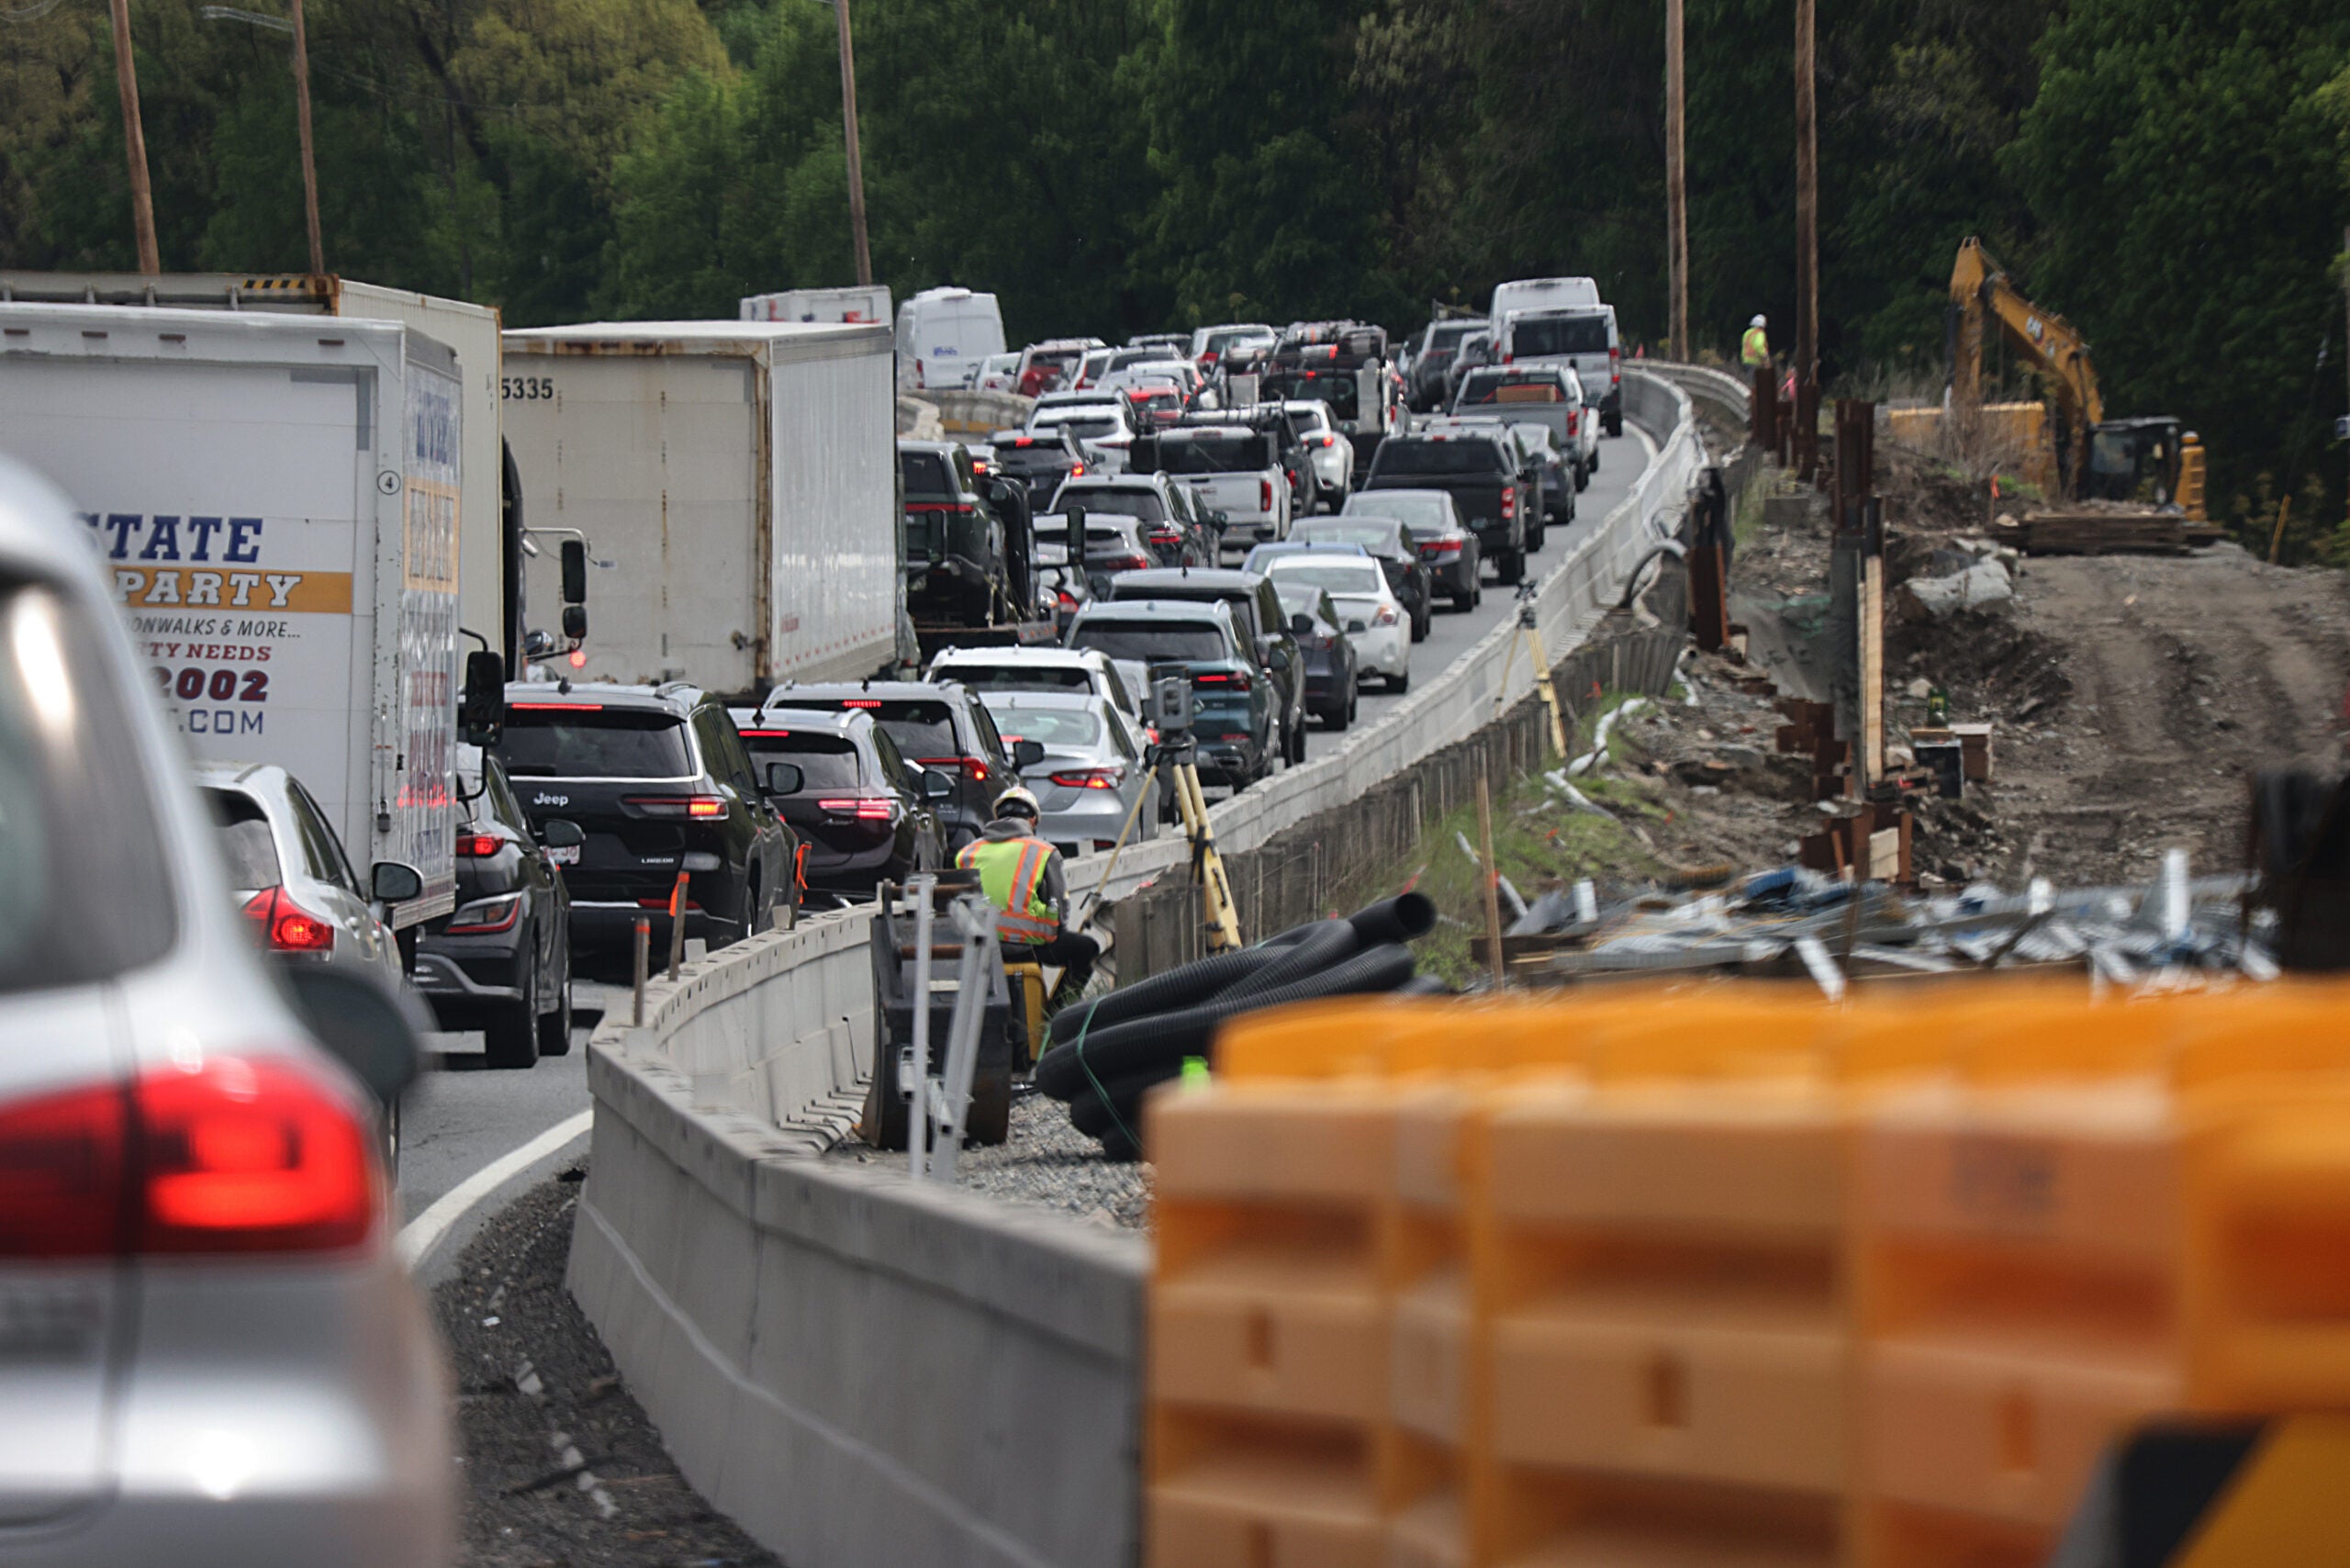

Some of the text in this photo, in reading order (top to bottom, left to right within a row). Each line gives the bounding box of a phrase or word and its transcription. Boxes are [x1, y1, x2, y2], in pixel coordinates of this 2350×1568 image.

[501, 377, 554, 400] 5335
[385, 476, 394, 489] 4
[114, 569, 303, 607] PARTY
[129, 616, 217, 635] ONWALKS
[220, 619, 232, 635] &
[185, 644, 272, 662] NEEDS
[533, 792, 569, 807] Jeep
